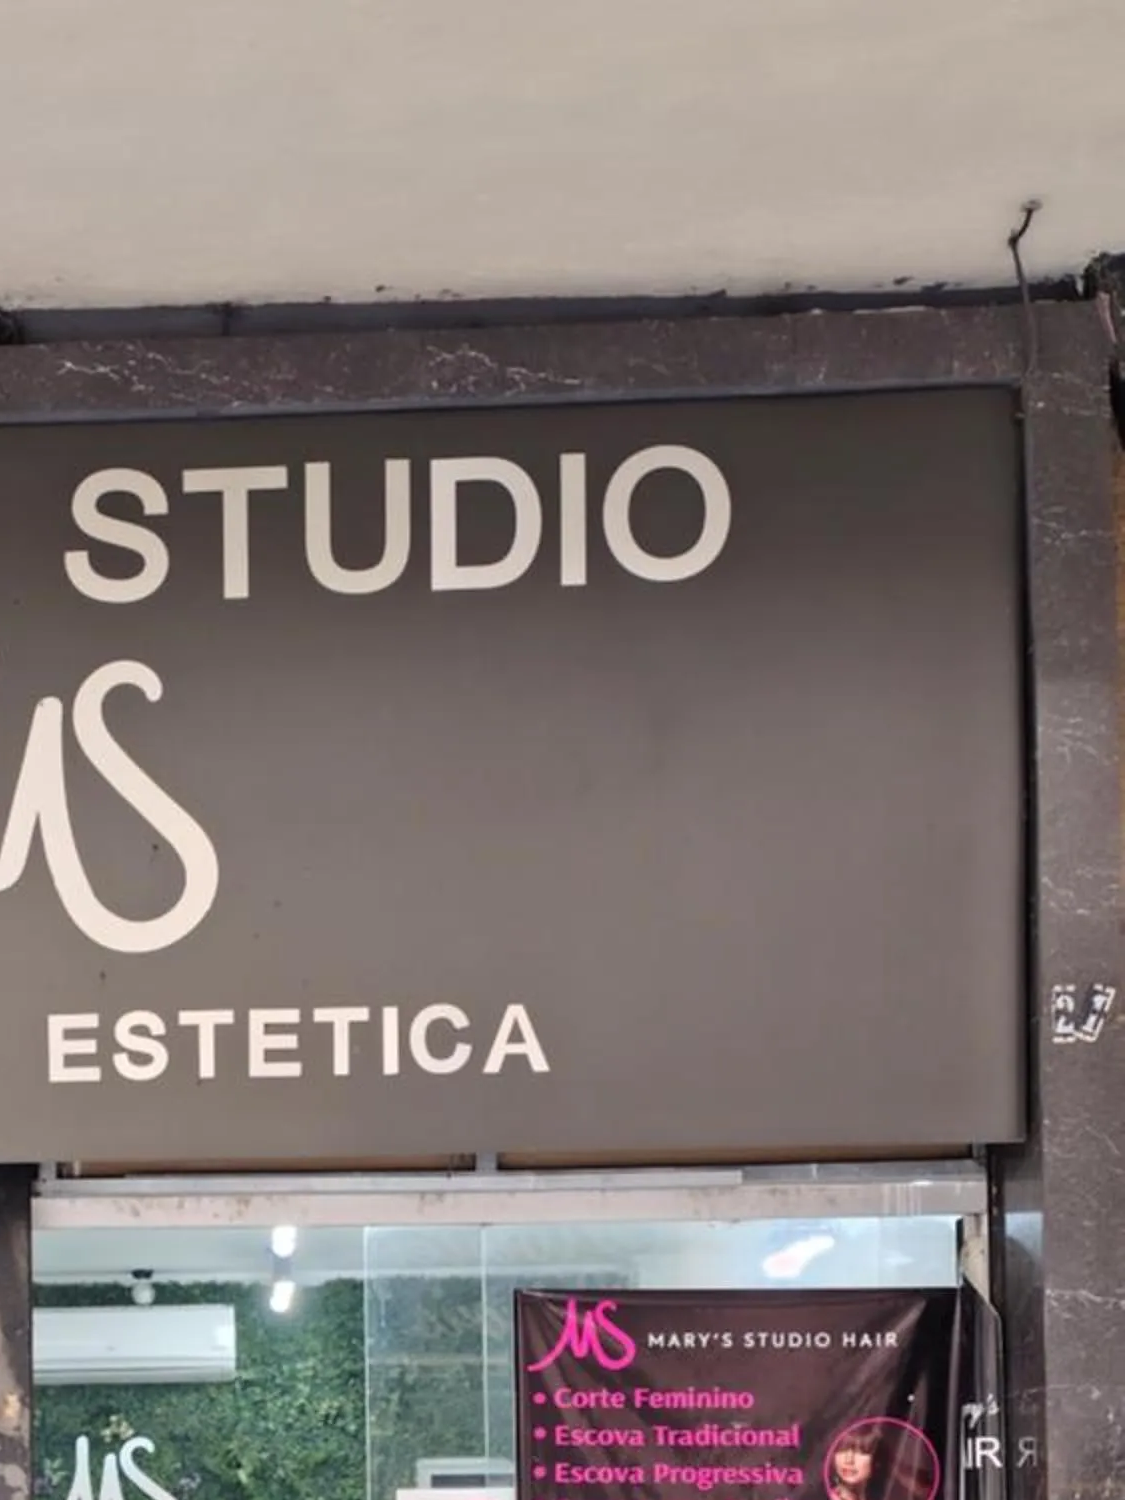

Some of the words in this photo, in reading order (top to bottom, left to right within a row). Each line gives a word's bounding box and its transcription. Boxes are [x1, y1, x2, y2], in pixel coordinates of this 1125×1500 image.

[66, 447, 729, 601] STUDIO
[48, 1004, 549, 1082] ESTETICA
[647, 1331, 733, 1349] MARY'S
[743, 1331, 831, 1349] STUDIO
[842, 1330, 899, 1348] HAIR
[553, 1387, 625, 1408] Corte
[634, 1388, 754, 1408] Feminino
[553, 1424, 646, 1447] Escova
[654, 1425, 801, 1447] Tradicional
[554, 1464, 646, 1484] Escova
[653, 1462, 803, 1490] Progressiva
